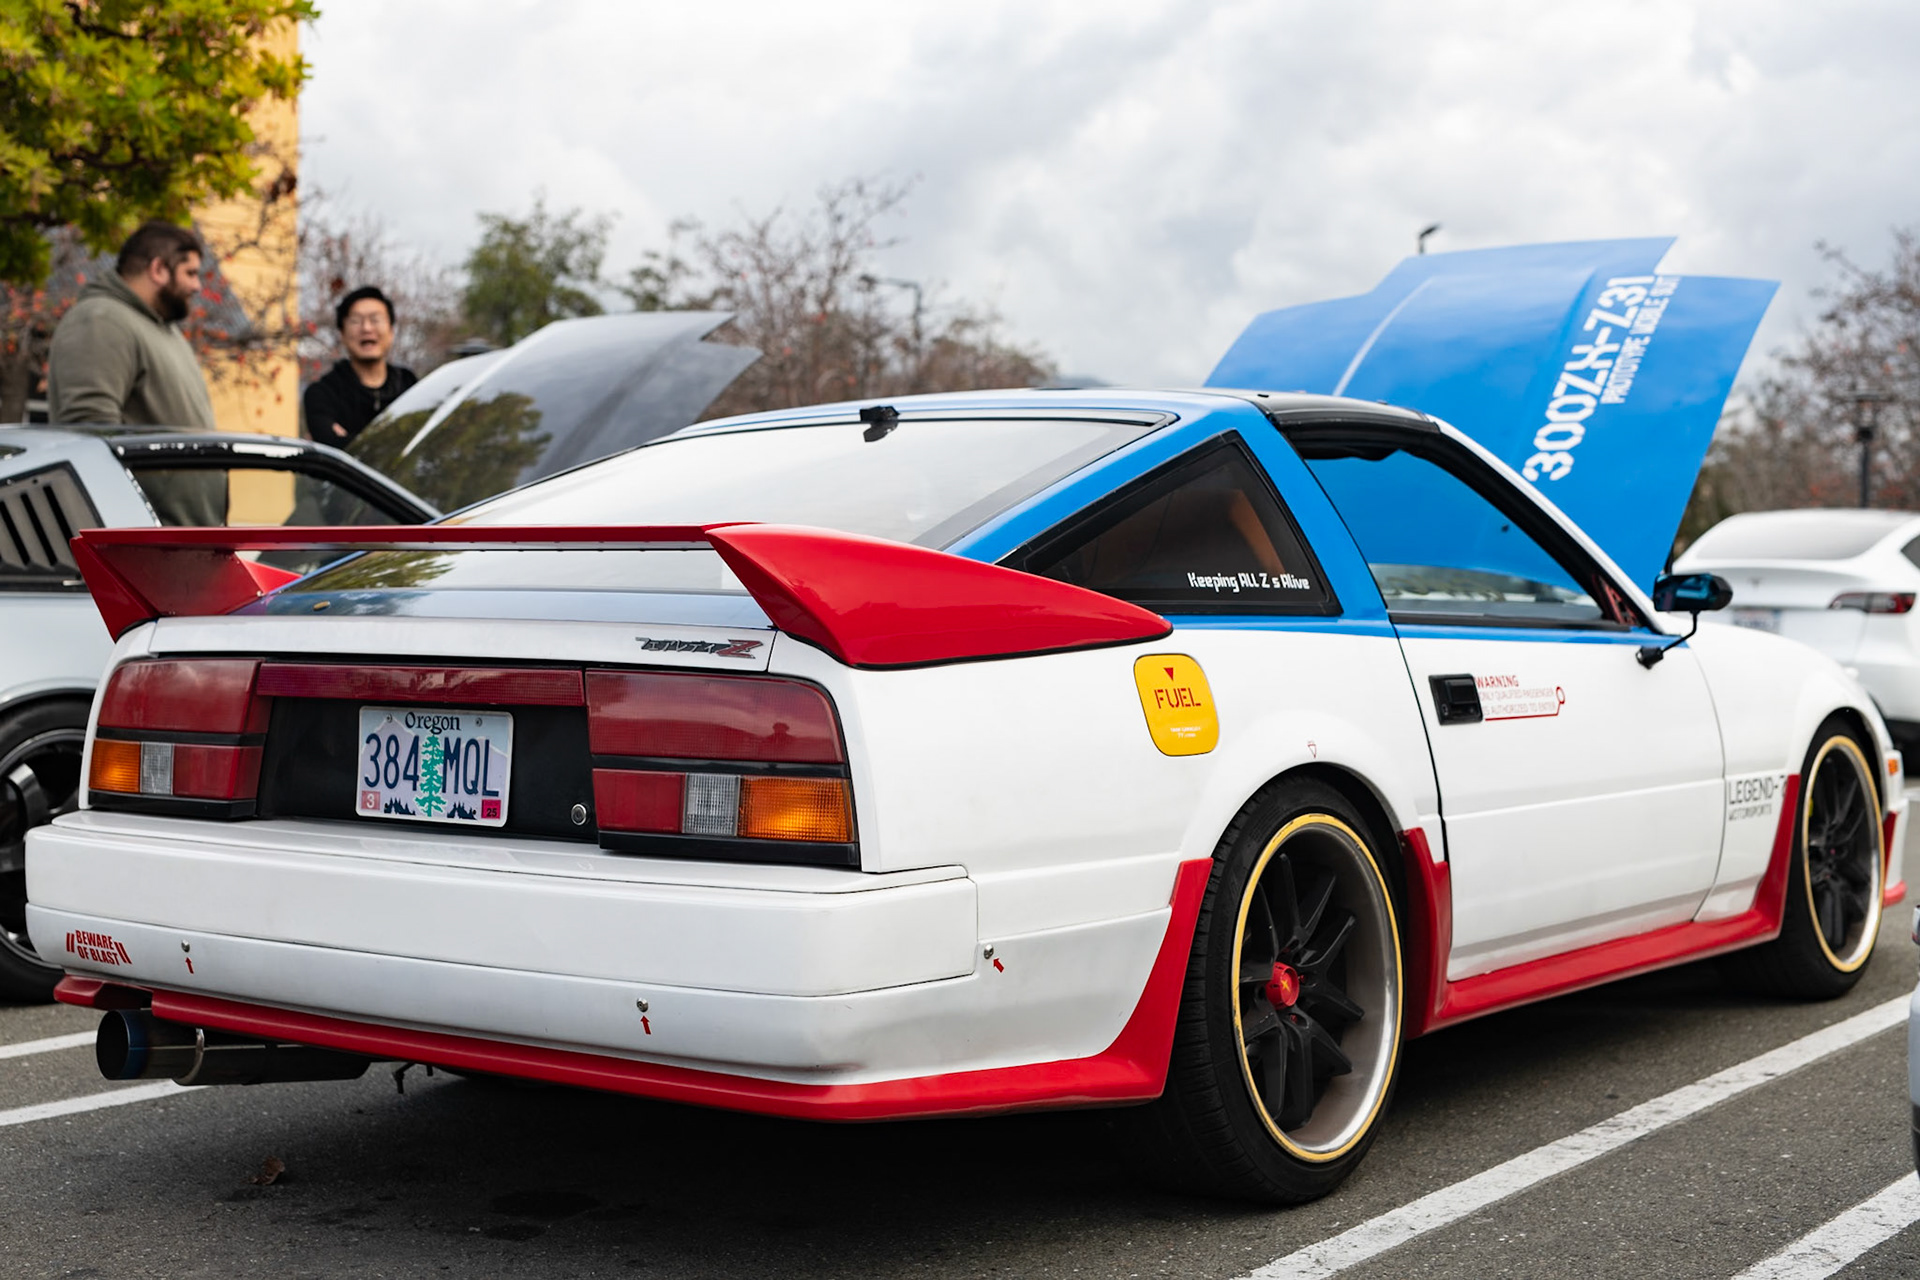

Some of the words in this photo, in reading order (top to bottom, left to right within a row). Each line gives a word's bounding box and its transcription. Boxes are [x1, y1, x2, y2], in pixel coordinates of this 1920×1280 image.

[1521, 275, 1655, 482] 300ZX-Z31
[1187, 572, 1240, 593] Keeping
[1259, 573, 1271, 588] Z
[1280, 573, 1310, 590] Alive
[1476, 675, 1519, 688] WARNING
[1154, 688, 1201, 709] FUEL
[405, 712, 461, 735] Oregon
[364, 733, 420, 792] 384
[442, 737, 500, 797] MQL
[366, 793, 375, 809] 3
[486, 807, 498, 818] 25
[75, 930, 114, 951] BEWARE
[77, 945, 90, 960] OF
[90, 948, 120, 965] BLAST
